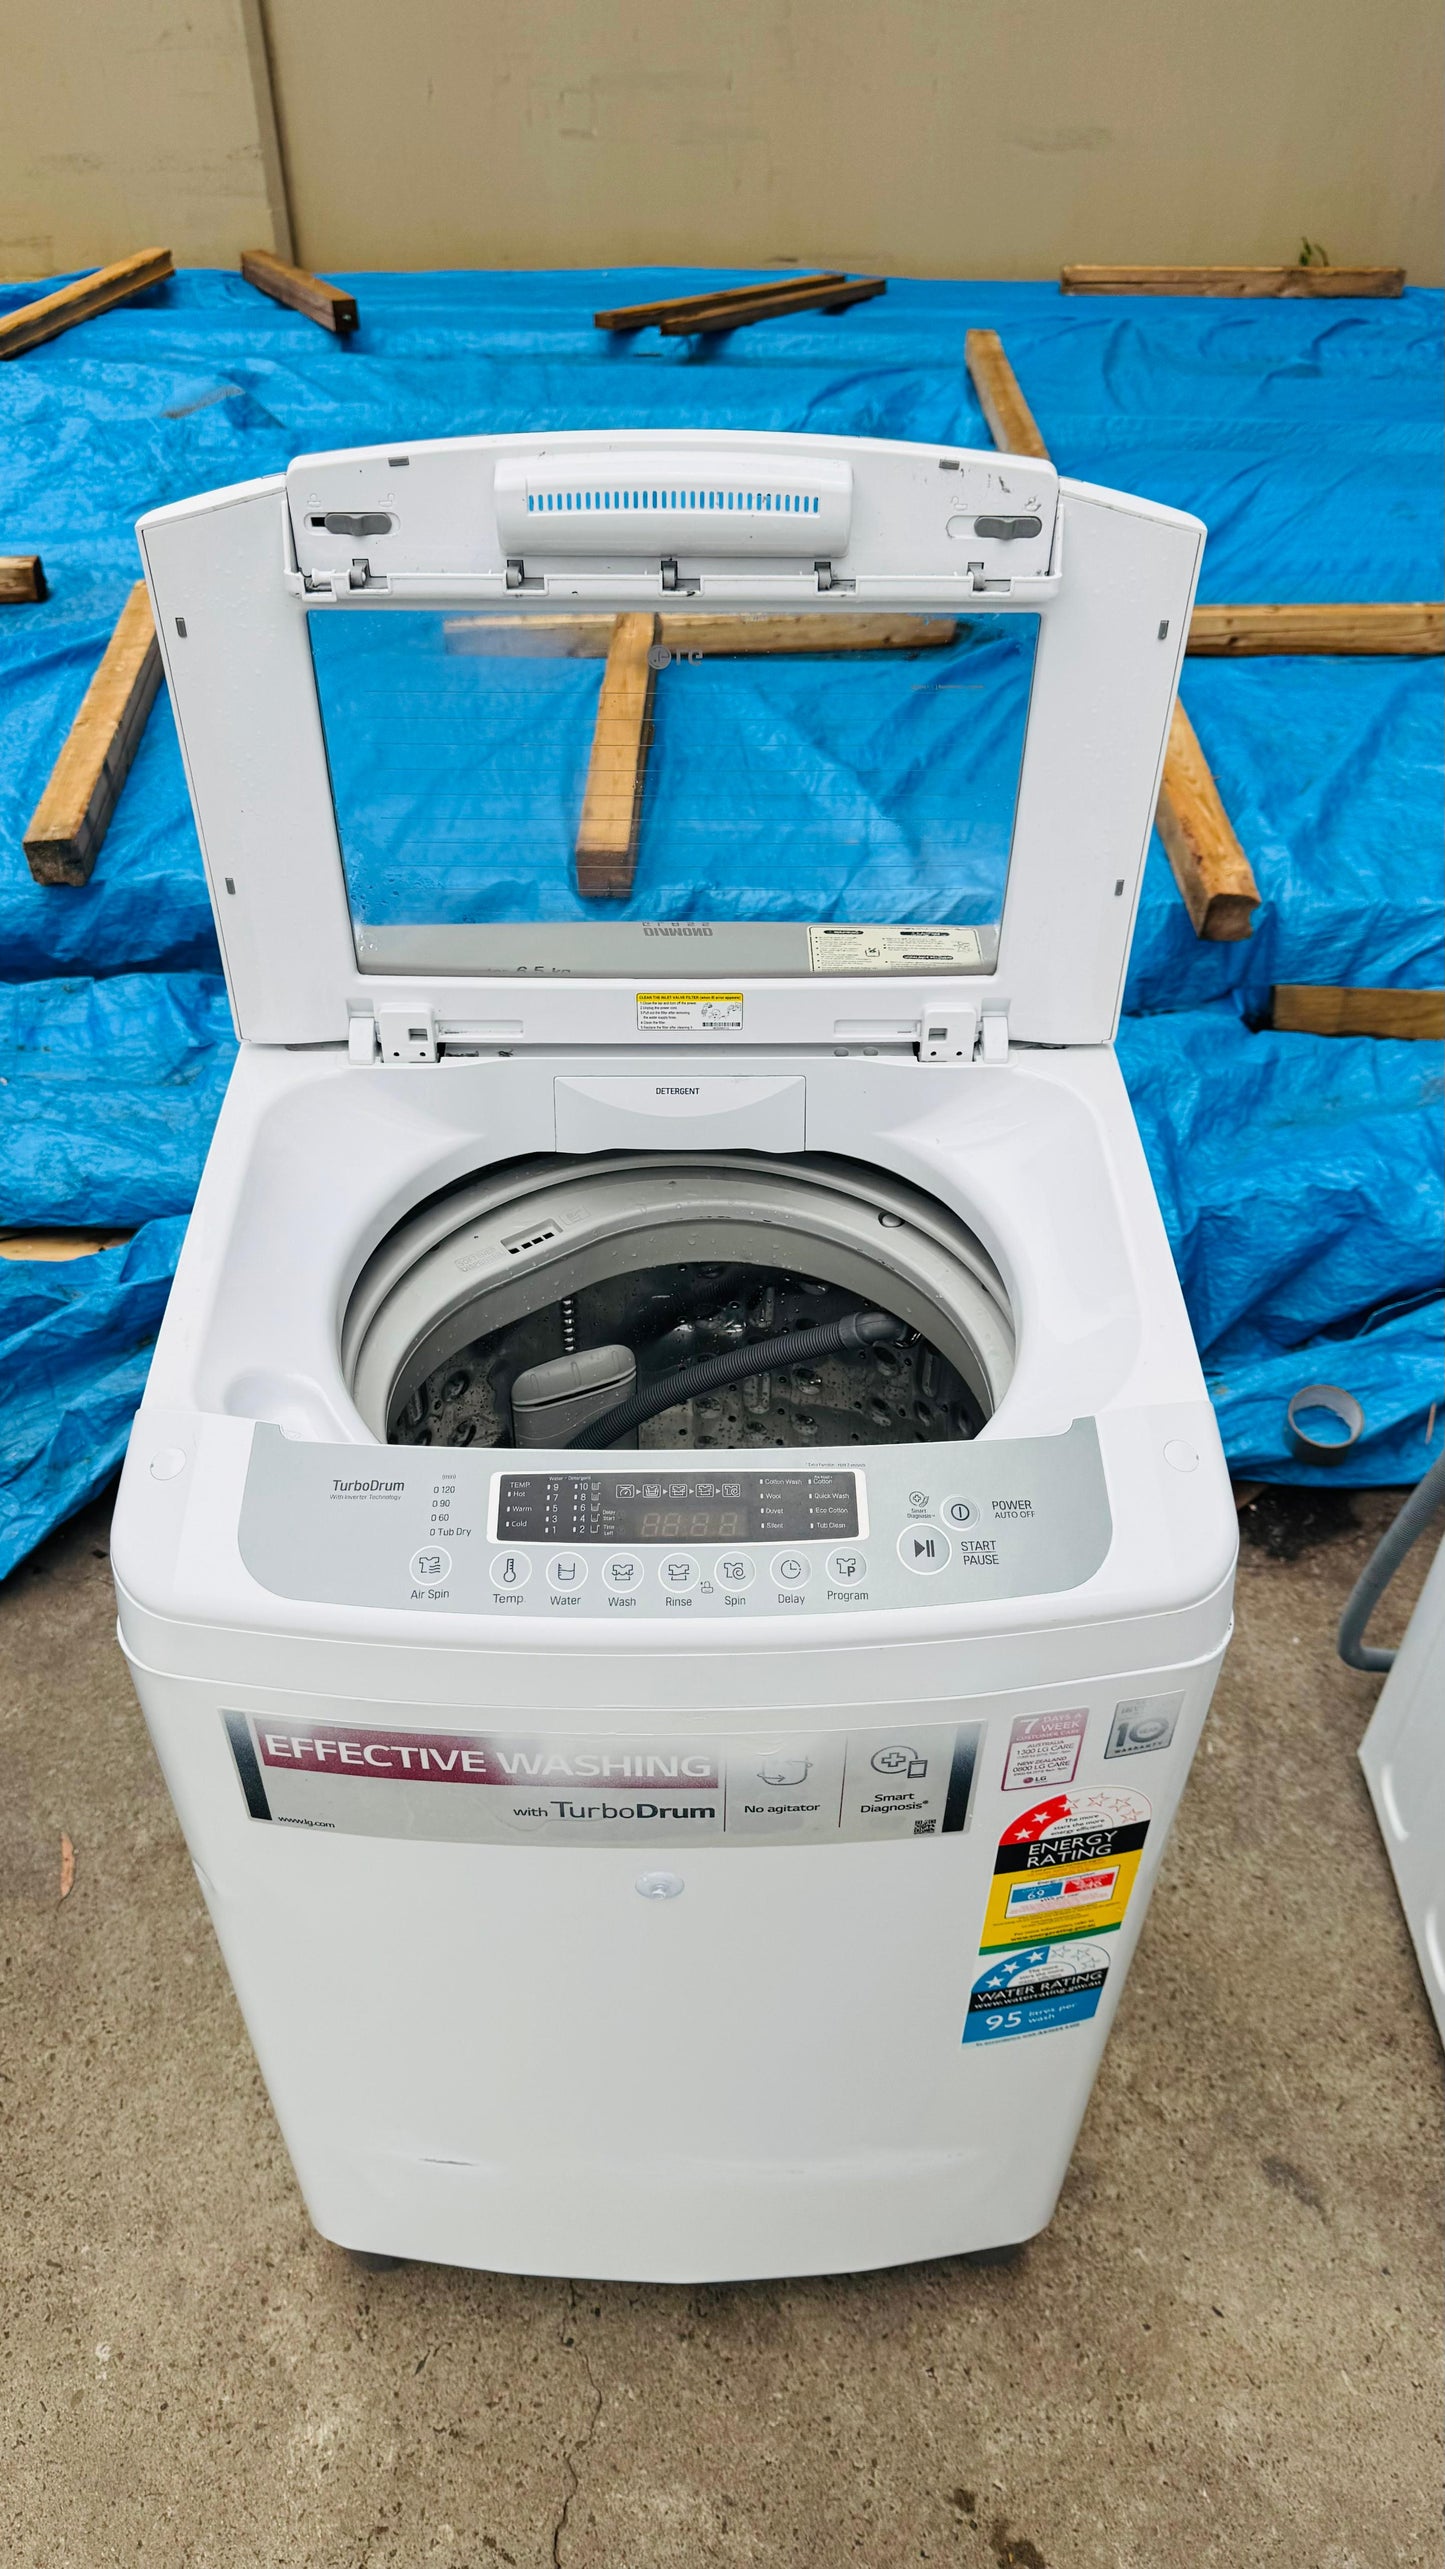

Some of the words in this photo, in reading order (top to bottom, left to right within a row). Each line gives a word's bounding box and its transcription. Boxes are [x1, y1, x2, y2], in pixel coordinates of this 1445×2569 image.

[333, 1479, 405, 1492] TurboDrum
[510, 1481, 531, 1489] TEMP
[553, 1483, 559, 1491] 9
[579, 1483, 588, 1491] 10
[992, 1499, 1032, 1511] POWER
[994, 1511, 1018, 1519] AUTO
[438, 1528, 454, 1536] Tub
[456, 1528, 471, 1537] Dry
[961, 1540, 996, 1552] START
[963, 1554, 999, 1565] PAUSE
[410, 1590, 425, 1599] Air
[428, 1589, 450, 1601] Spin
[493, 1594, 524, 1605] Temp
[550, 1595, 581, 1606] Water
[778, 1594, 805, 1605] Delay
[827, 1591, 869, 1603] Program
[608, 1596, 637, 1607] Wash
[665, 1597, 692, 1607] Rinse
[724, 1596, 746, 1607] Spin
[1020, 1718, 1039, 1734] 7
[1041, 1720, 1080, 1732] WEEK
[1051, 1743, 1074, 1751] CARE
[265, 1733, 487, 1773] EFFECTIVE
[496, 1752, 711, 1777] WASHING
[1035, 1756, 1067, 1764] ZEALAND
[1012, 1765, 1032, 1773] 0800
[1048, 1760, 1070, 1768] CARE
[874, 1793, 915, 1802] Smart
[513, 1807, 548, 1817] with
[550, 1801, 715, 1819] TurboDrum
[744, 1805, 765, 1814] No
[767, 1802, 820, 1814] agitator
[277, 1815, 335, 1829] www.lg.com
[1076, 1824, 1103, 1832] efficient
[1028, 1830, 1118, 1856] ENERGY
[1027, 1844, 1112, 1868] RATING
[1027, 1889, 1045, 1900] 69
[977, 1985, 1034, 2002] WATER
[1041, 1971, 1104, 1991] RATING
[985, 2011, 1022, 2031] 95
[1058, 2003, 1075, 2011] per
[1028, 2014, 1055, 2023] wash
